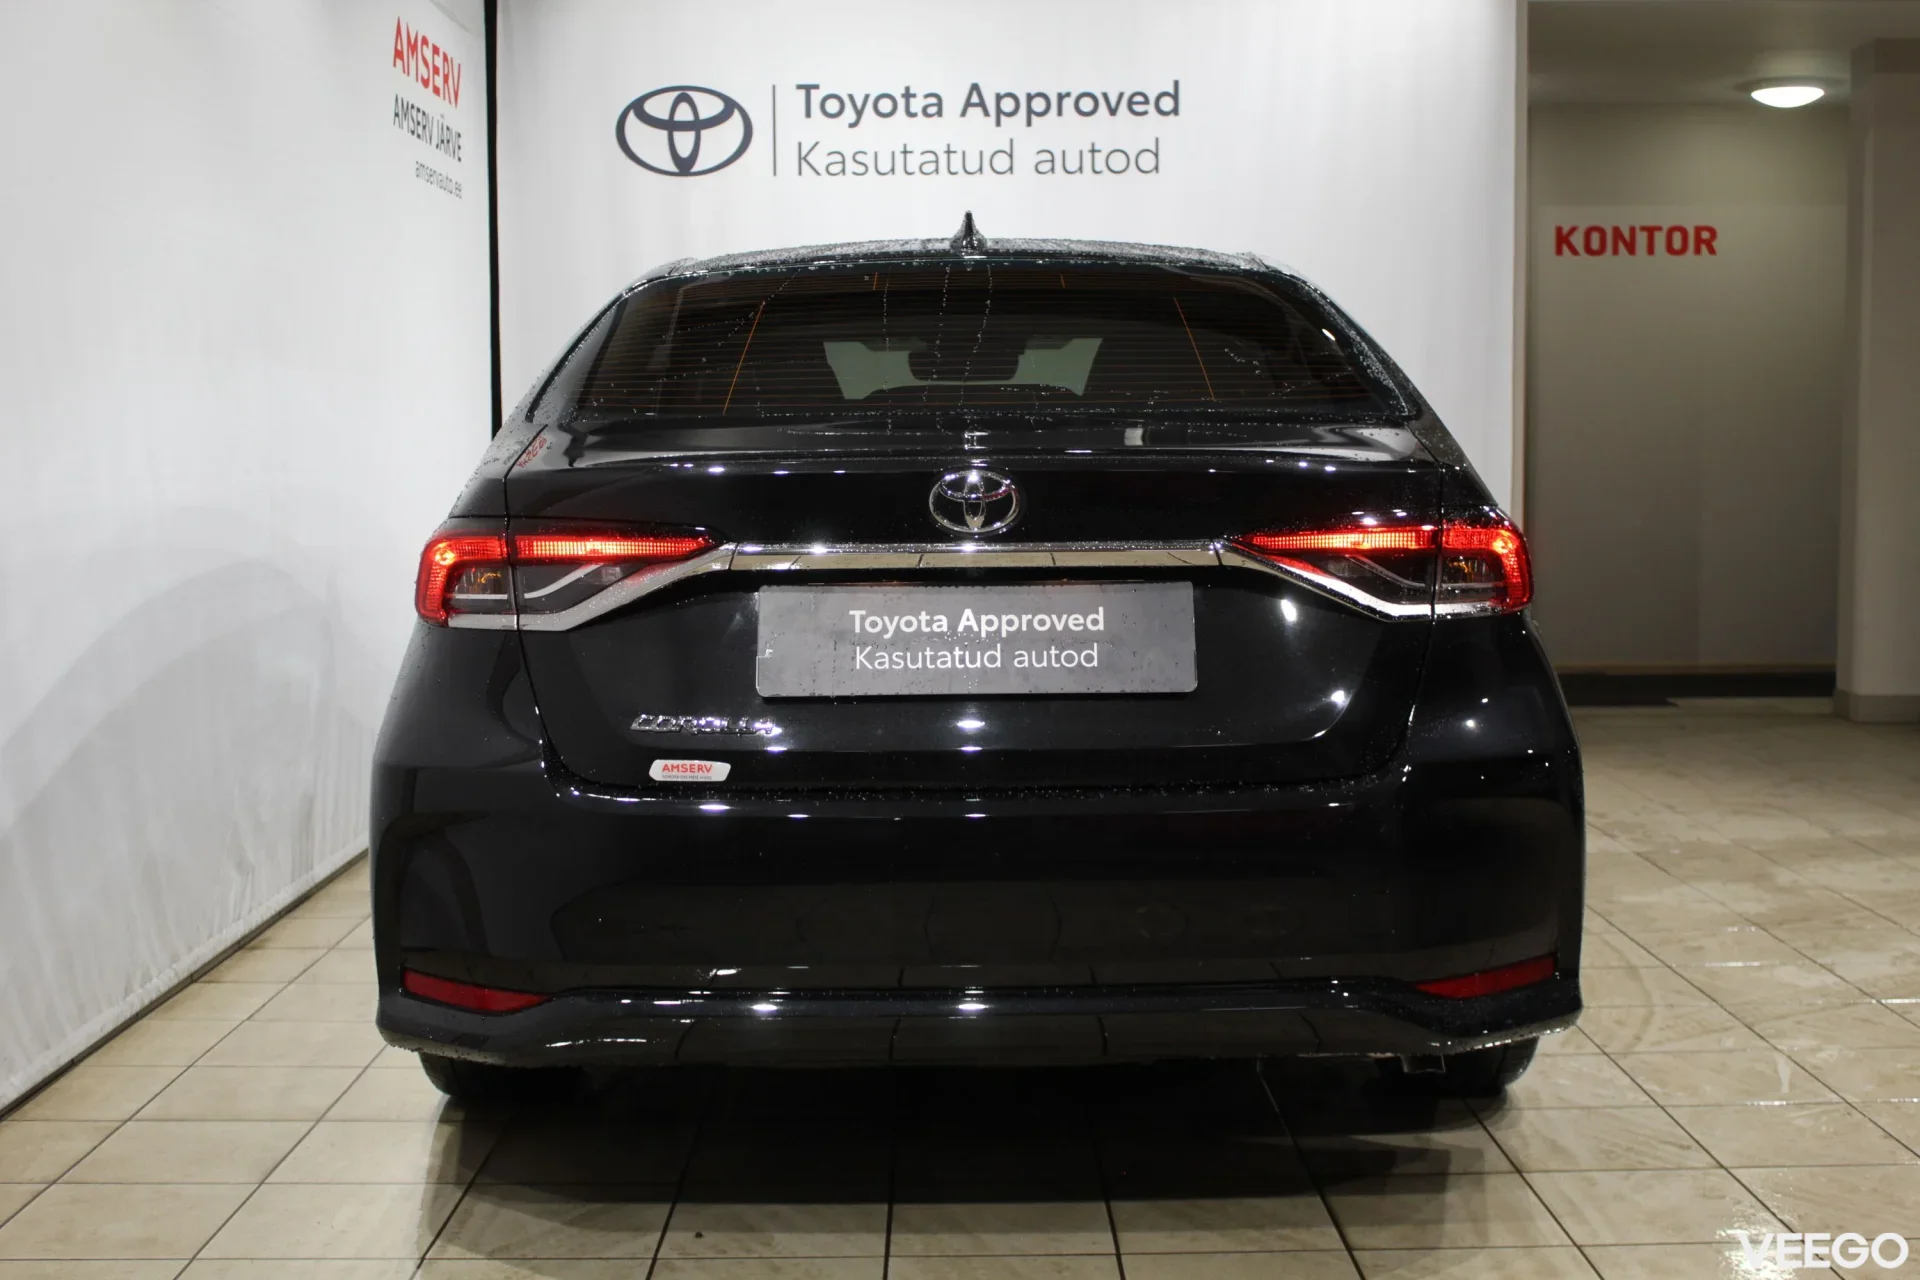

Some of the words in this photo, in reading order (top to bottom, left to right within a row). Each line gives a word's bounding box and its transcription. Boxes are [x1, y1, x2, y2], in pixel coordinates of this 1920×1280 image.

[393, 16, 462, 109] AMSERV
[796, 84, 944, 128] Toyota
[960, 80, 1181, 127] Approved
[393, 94, 434, 146] AMSERV
[436, 113, 462, 162] JÄRVE
[797, 138, 1015, 177] Kasutatud
[1034, 137, 1160, 175] autod
[415, 160, 463, 199] amservauto.ee
[1555, 225, 1718, 256] KONTOR
[849, 610, 948, 639] Toyota
[957, 607, 1105, 637] Approved
[855, 644, 1001, 670] Kasutatud
[1013, 643, 1099, 669] autod
[661, 763, 713, 773] AMSERV
